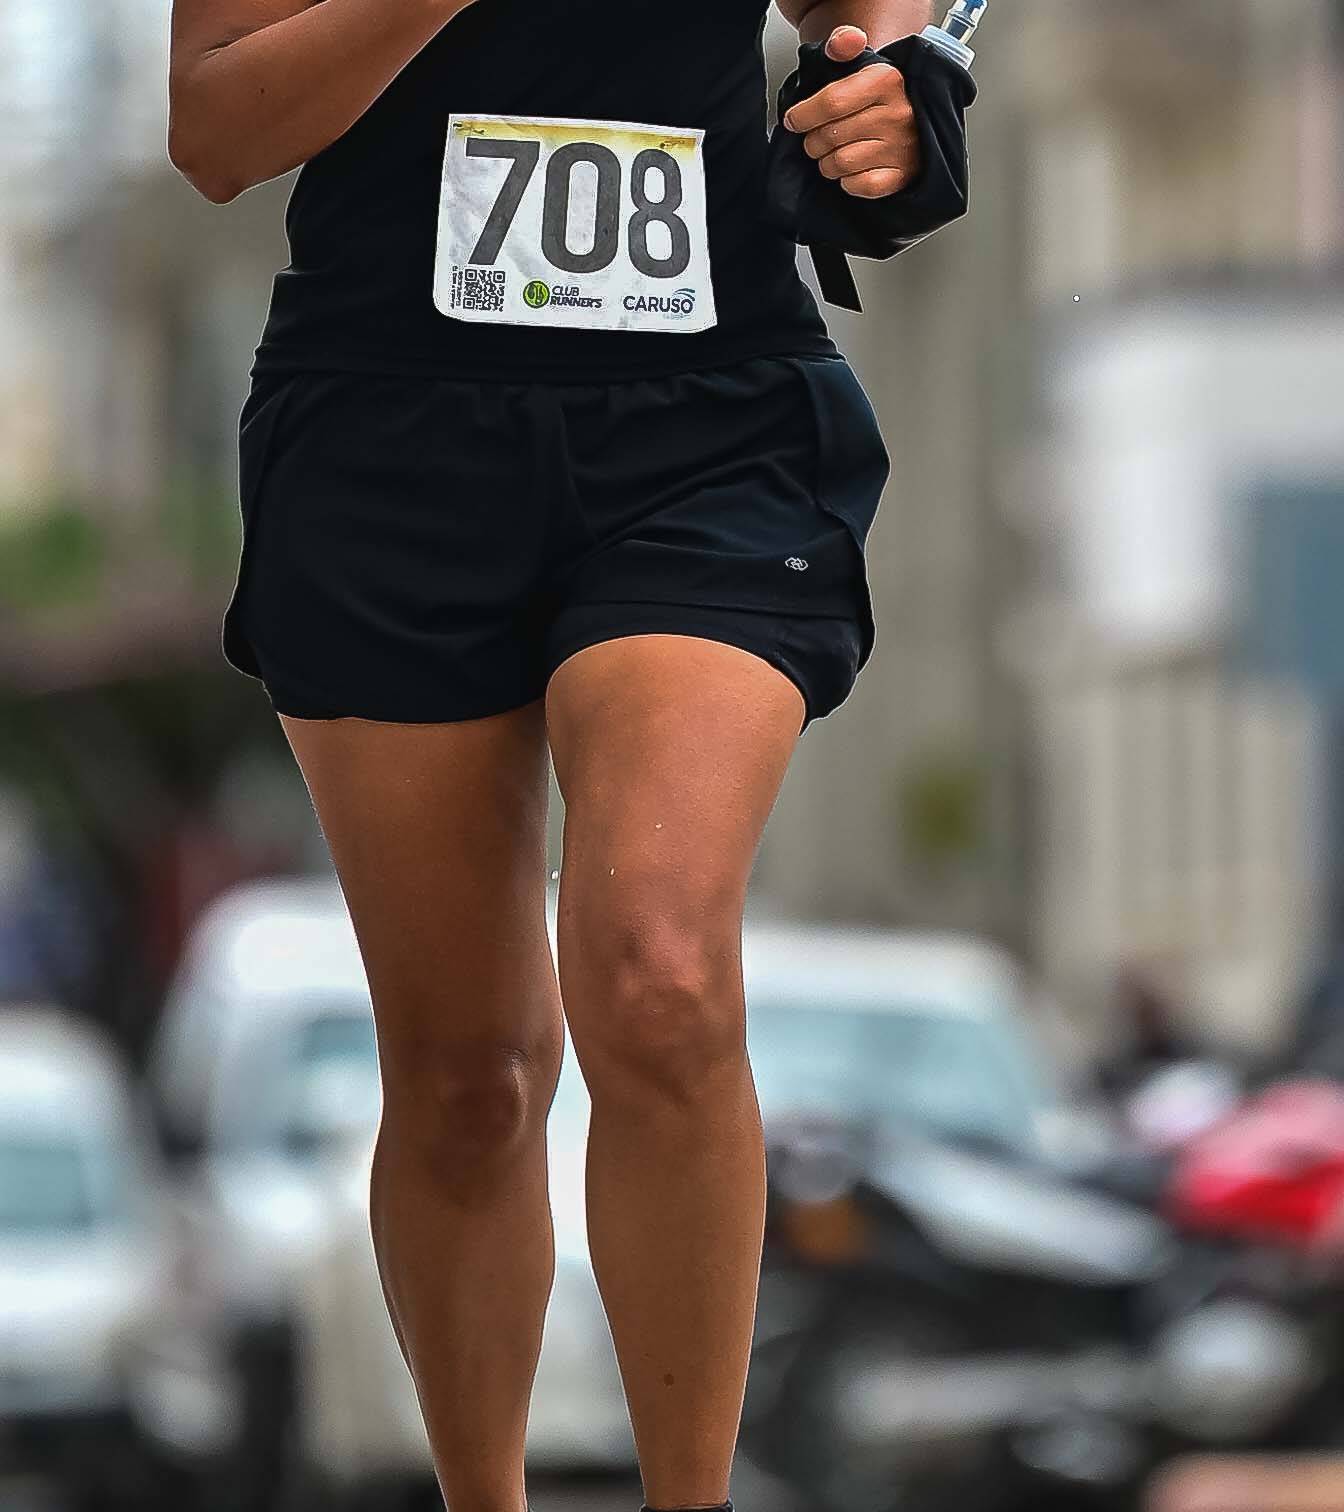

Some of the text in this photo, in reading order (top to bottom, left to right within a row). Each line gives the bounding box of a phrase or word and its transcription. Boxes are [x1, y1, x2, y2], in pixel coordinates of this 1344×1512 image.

[465, 136, 692, 280] 708
[551, 285, 580, 297] CLUB
[549, 295, 604, 310] RUNNER'S
[622, 295, 694, 314] CARUSO
